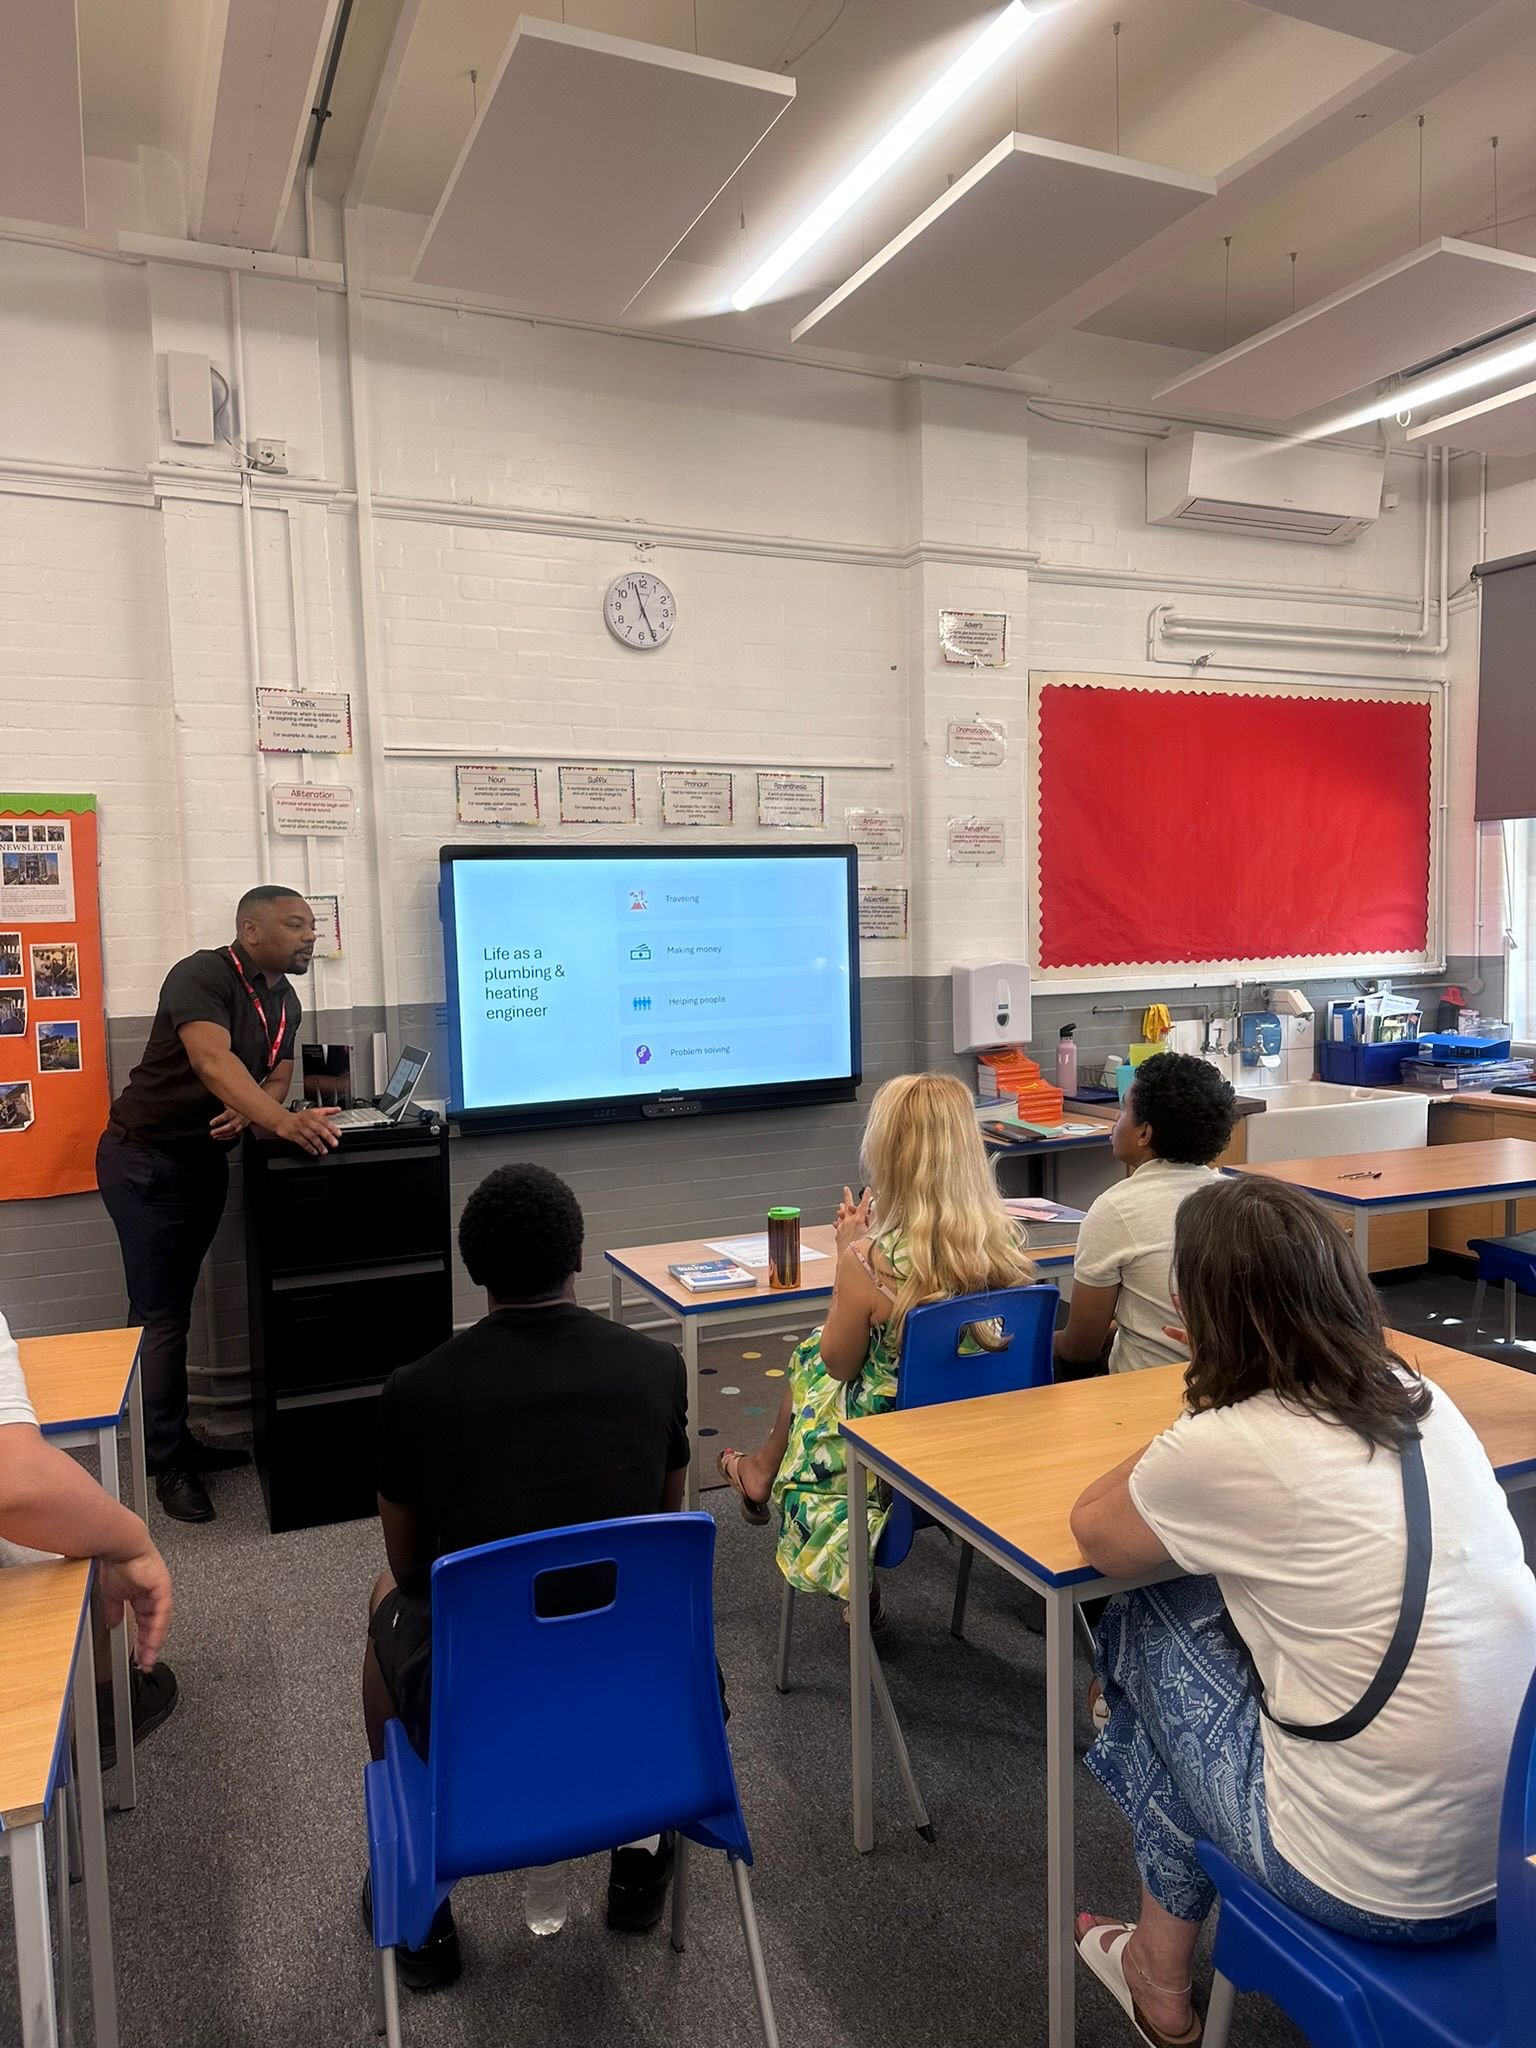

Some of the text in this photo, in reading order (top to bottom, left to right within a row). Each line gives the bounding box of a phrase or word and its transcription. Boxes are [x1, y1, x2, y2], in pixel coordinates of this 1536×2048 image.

[627, 581, 634, 590] 11
[639, 579, 647, 589] 12
[653, 585, 656, 593] 1
[618, 590, 627, 599] 10
[660, 596, 666, 605] 2
[615, 602, 621, 610] 9
[662, 609, 669, 617] 3
[618, 615, 624, 624] 8
[626, 626, 632, 634] 7
[659, 621, 665, 630] 4
[639, 632, 644, 640] 6
[291, 699, 316, 708] Prefix
[587, 776, 608, 784] Suffix
[684, 780, 709, 788] Pronoun
[291, 789, 335, 799] Alliteration
[666, 895, 700, 903] Traveling
[484, 947, 542, 960] Life as a
[667, 946, 722, 955] Making money
[485, 964, 565, 983] plumbing &
[485, 986, 539, 1001] heating
[669, 996, 726, 1006] Helping people
[486, 1005, 548, 1021] engineer
[671, 1046, 731, 1056] Problem solving
